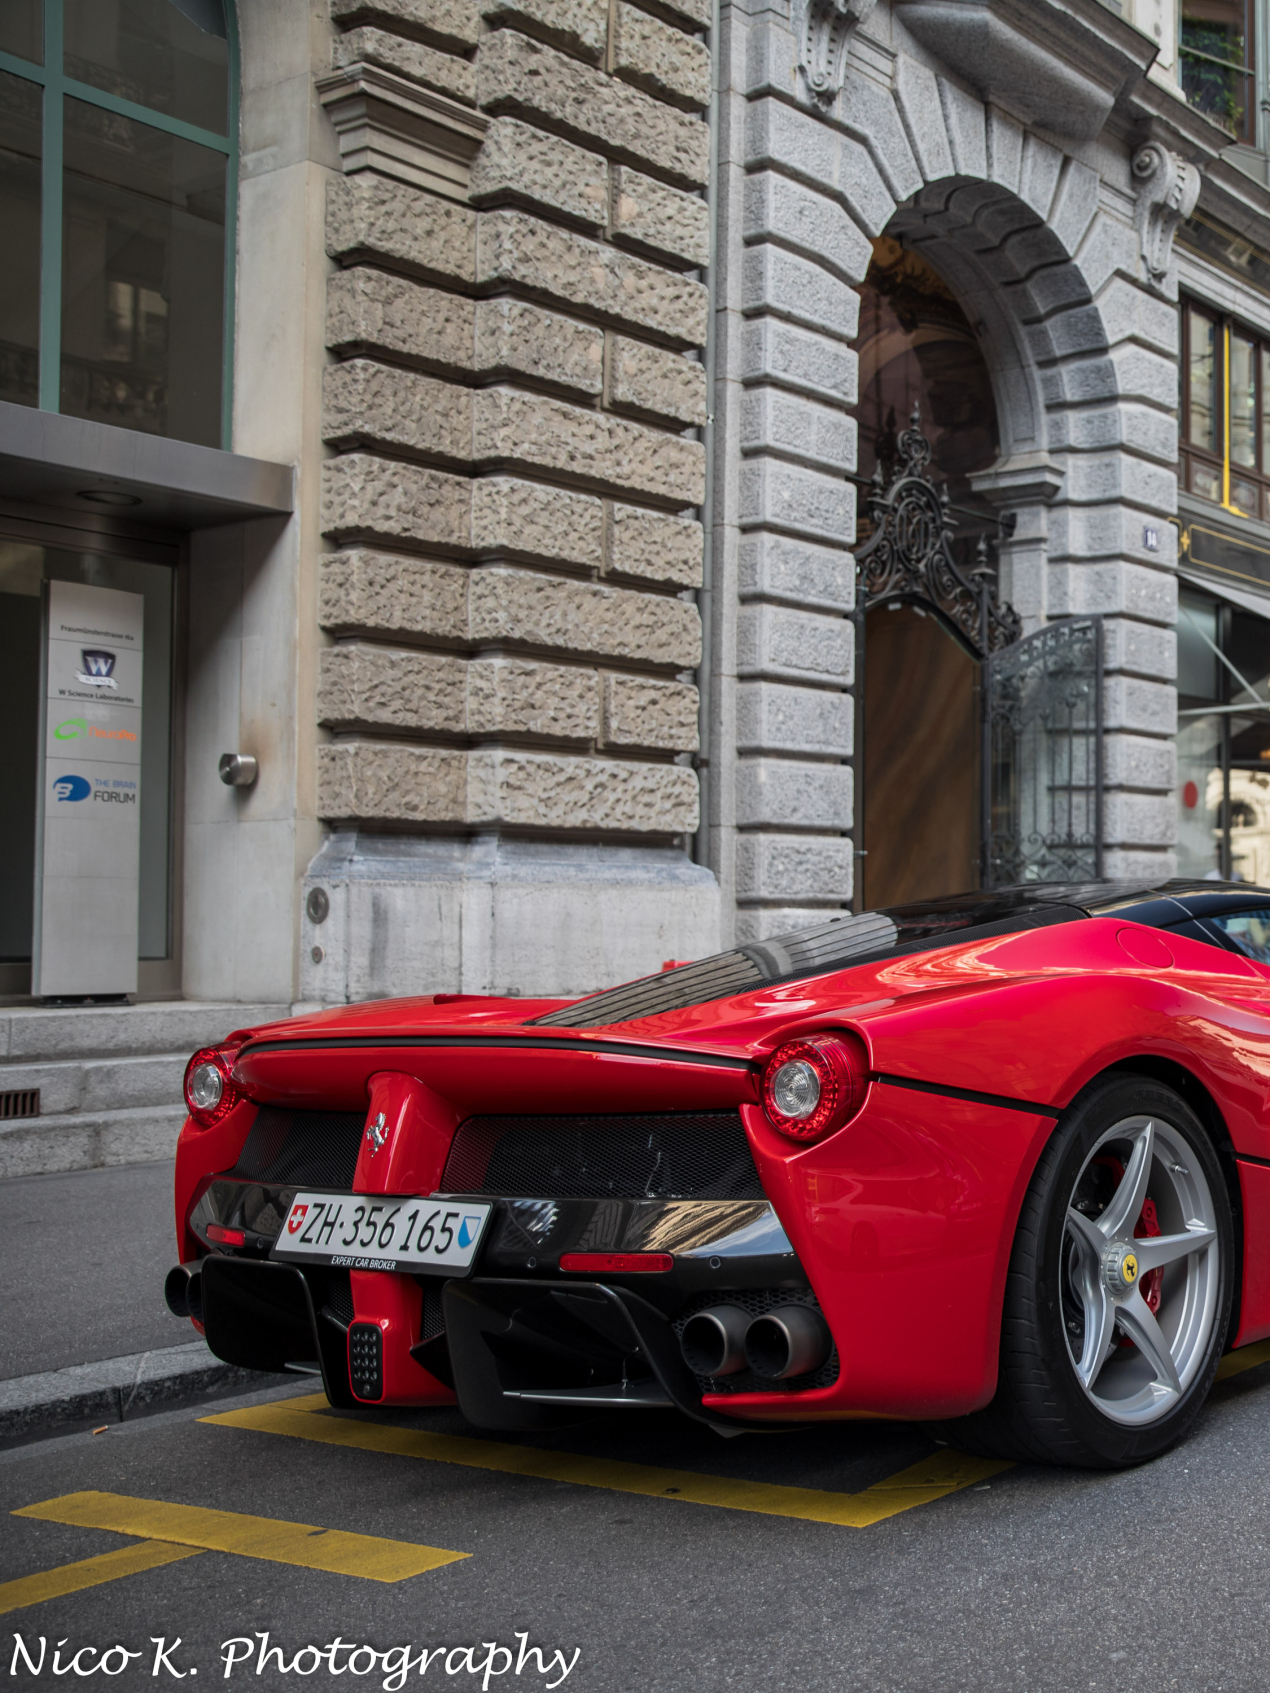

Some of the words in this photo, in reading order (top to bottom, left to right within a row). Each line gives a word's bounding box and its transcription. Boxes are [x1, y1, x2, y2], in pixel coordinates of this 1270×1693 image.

[85, 655, 113, 676] W
[58, 688, 66, 696] W
[67, 690, 94, 699] Science
[95, 692, 135, 704] Laboratories
[88, 726, 137, 742] NeuroPro
[94, 778, 110, 788] THE
[112, 780, 137, 790] BRAIN
[93, 790, 136, 804] FORUM
[331, 1255, 356, 1266] EXPERT
[355, 1257, 370, 1268] CAR
[369, 1258, 397, 1271] BROKER
